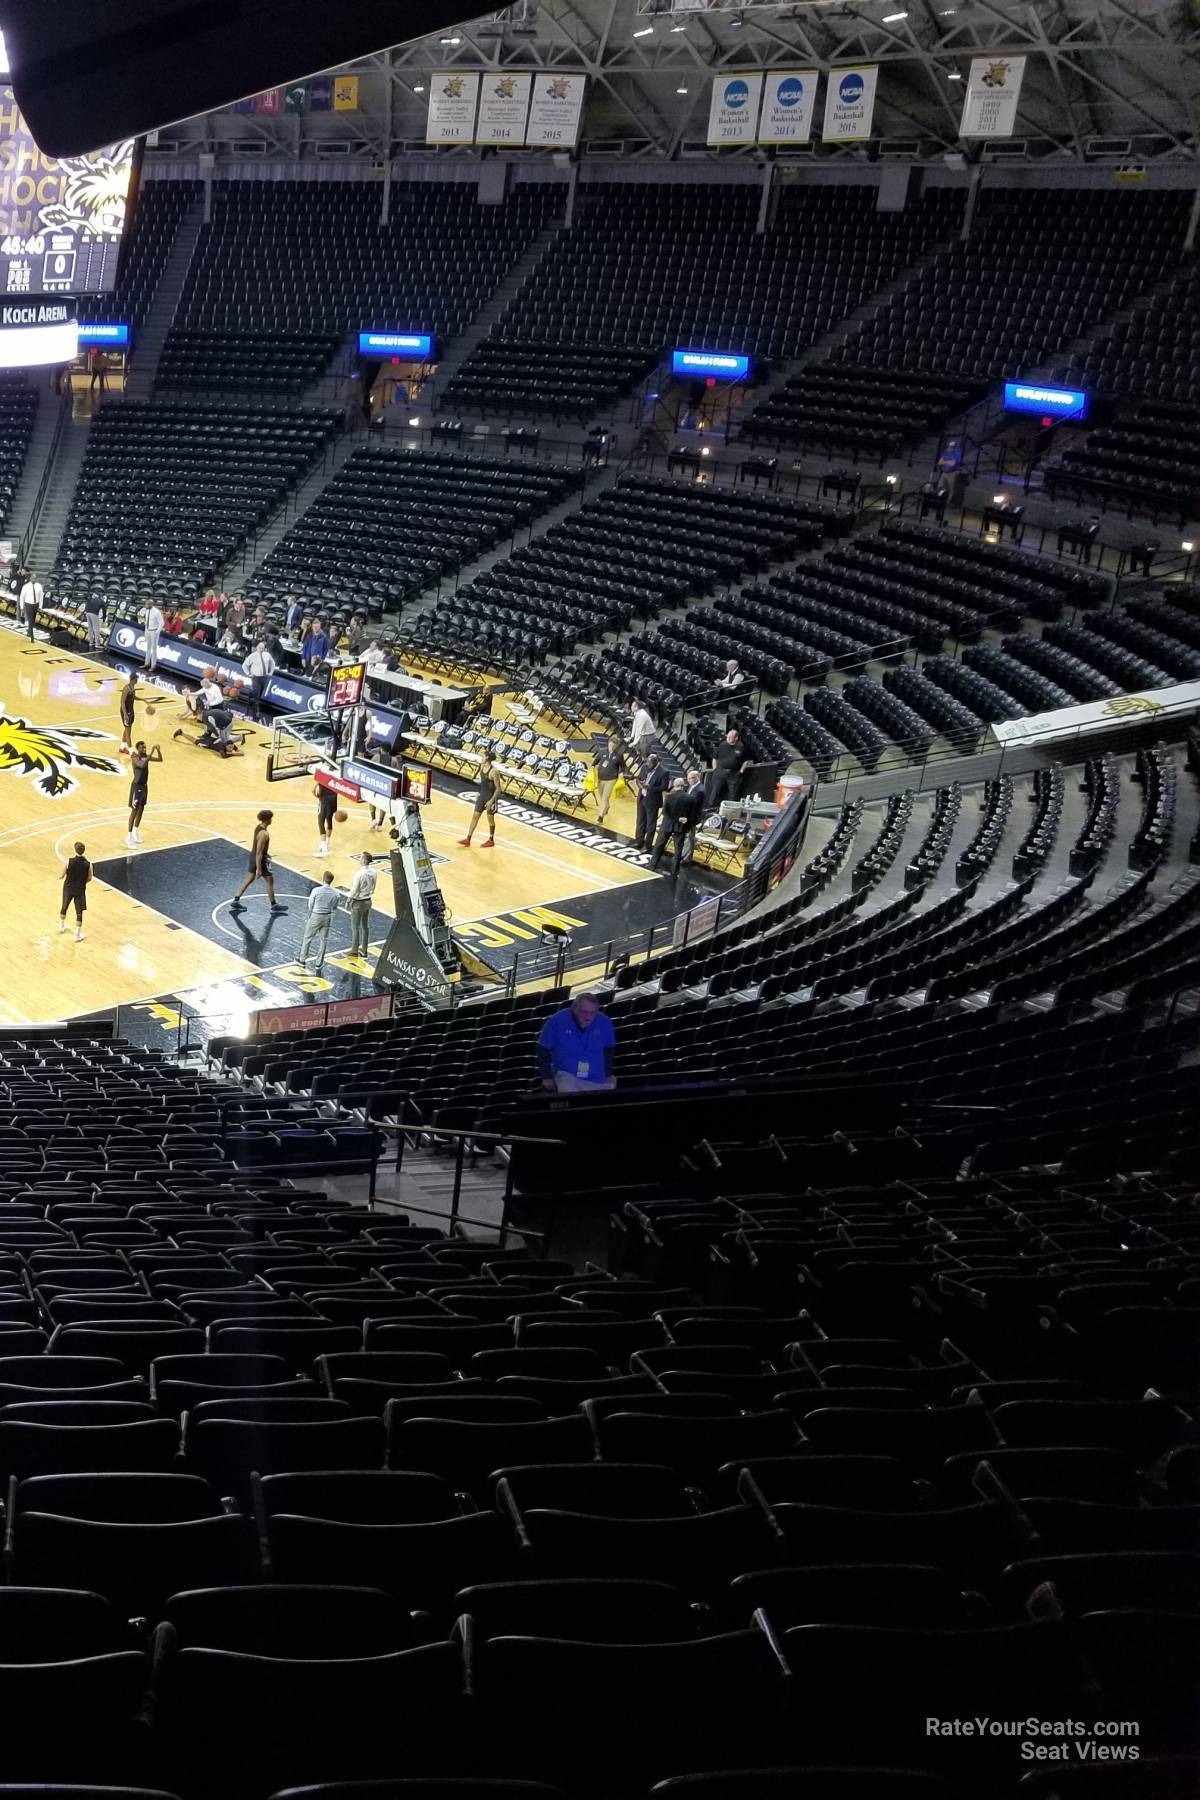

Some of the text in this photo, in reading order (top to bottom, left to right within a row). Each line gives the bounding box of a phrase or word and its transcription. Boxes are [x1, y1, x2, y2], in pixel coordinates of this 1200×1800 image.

[779, 92, 803, 100] NCAA
[841, 88, 864, 96] NCAA
[726, 93, 749, 102] NCAA
[718, 116, 749, 124] Basketball
[770, 115, 803, 123] Basketball
[833, 112, 864, 121] Basketball
[441, 128, 459, 136] 2013
[721, 126, 743, 136] 2013
[774, 126, 796, 136] 2014
[837, 122, 857, 132] 2015
[492, 128, 510, 138] 2014
[542, 130, 562, 140] 2015
[54, 254, 66, 274] 0
[2, 307, 36, 324] KOCH
[37, 305, 68, 323] ARENA
[334, 665, 361, 681] 45:40
[270, 684, 303, 704] Consulting
[360, 773, 389, 791] Kansas
[386, 950, 416, 976] KANSAS
[425, 974, 447, 996] STAR
